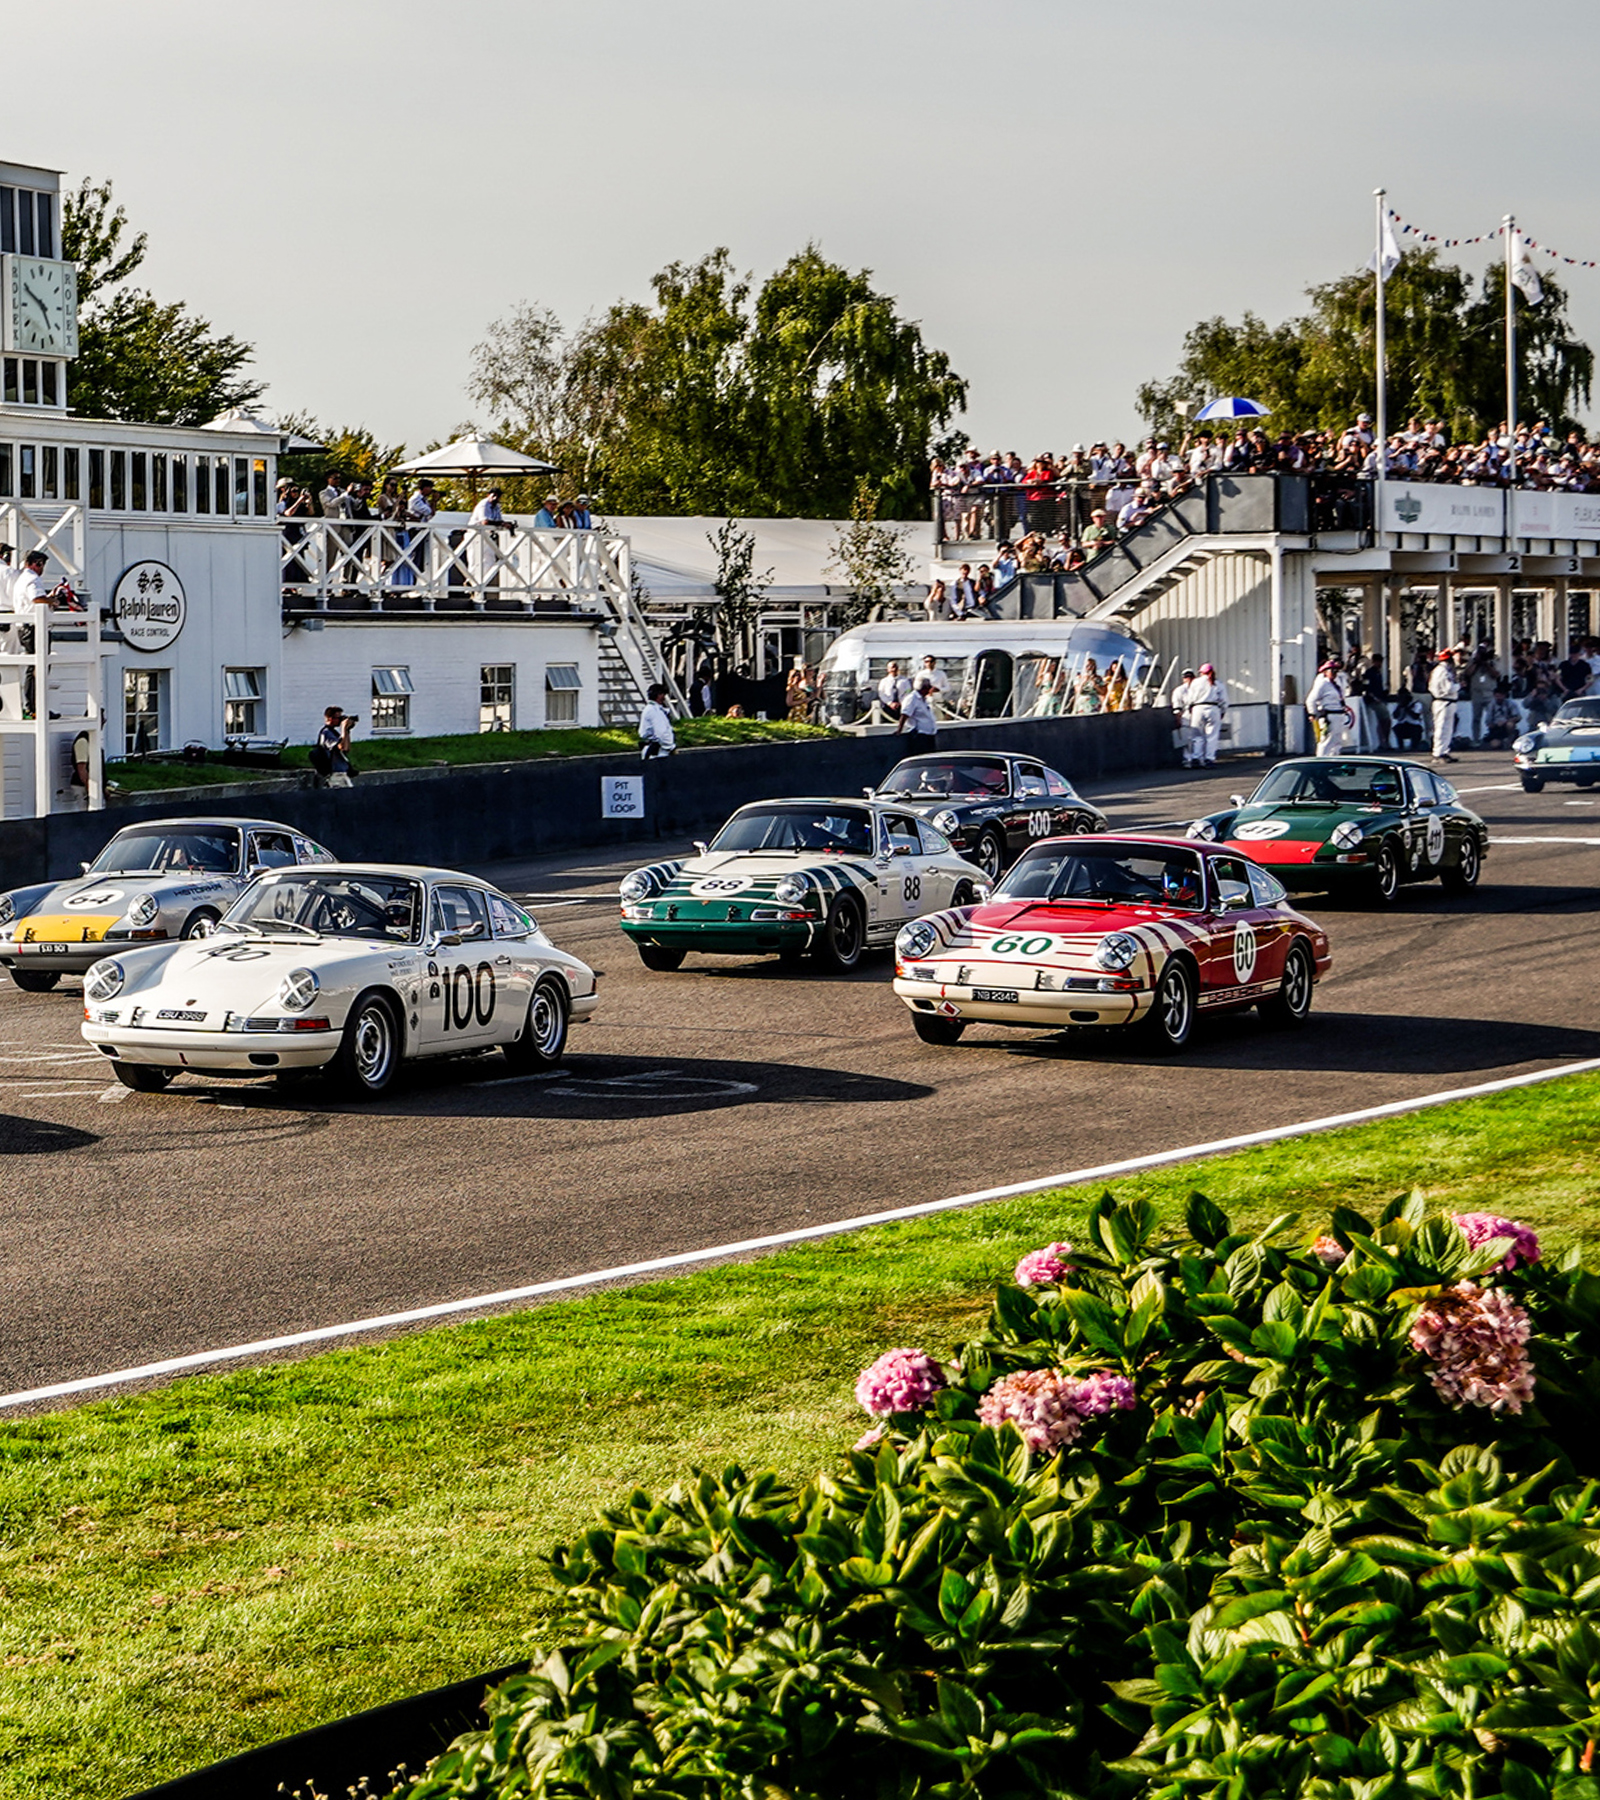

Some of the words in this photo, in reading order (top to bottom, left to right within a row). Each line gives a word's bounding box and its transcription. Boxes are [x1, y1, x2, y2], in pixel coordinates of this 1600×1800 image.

[64, 274, 73, 346] ROLEX
[1508, 556, 1519, 570] 2
[1568, 558, 1578, 572] 3
[120, 597, 146, 620] Ralph
[145, 595, 180, 625] Lauren
[130, 628, 145, 637] RACE
[146, 628, 170, 637] CONTROL
[615, 781, 629, 790] PIT
[612, 793, 632, 802] OUT
[610, 804, 636, 813] LOOP
[1028, 811, 1050, 837] 600
[700, 880, 744, 890] 88
[904, 876, 921, 901] 88
[69, 894, 115, 904] 64
[274, 888, 296, 919] 64
[991, 935, 1053, 955] 60
[1236, 931, 1255, 971] 60
[442, 961, 496, 1031] 100
